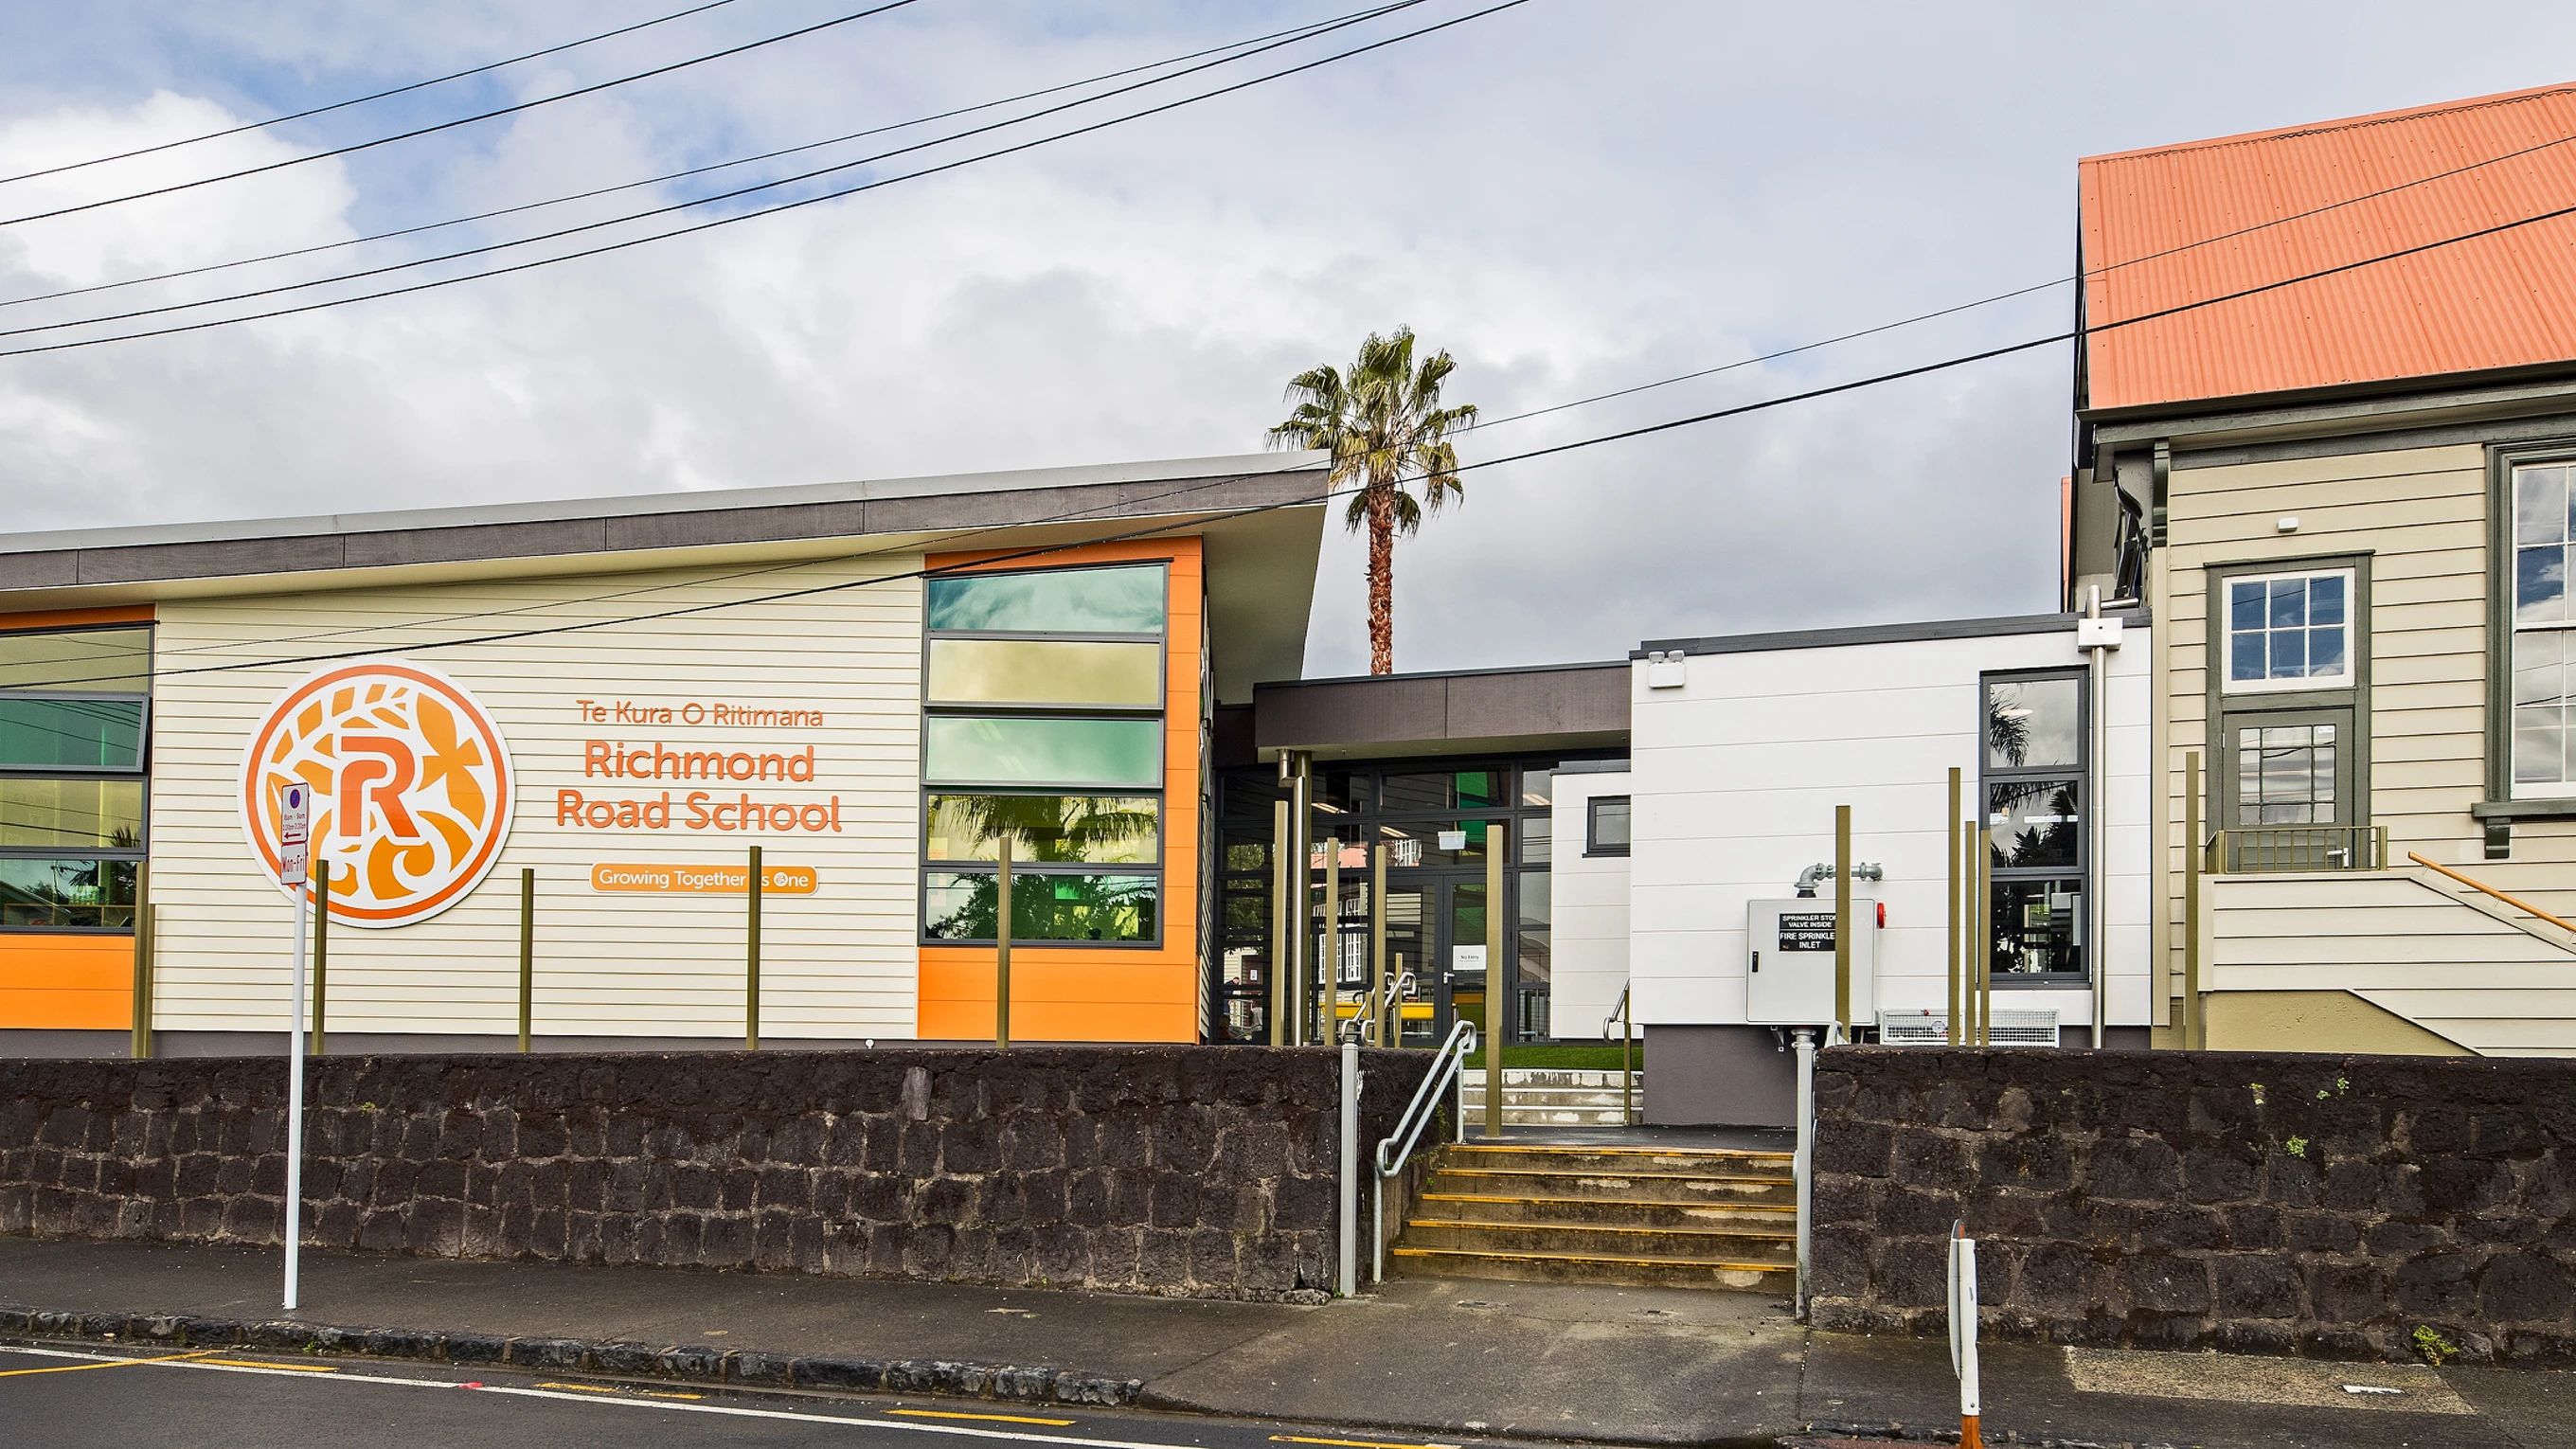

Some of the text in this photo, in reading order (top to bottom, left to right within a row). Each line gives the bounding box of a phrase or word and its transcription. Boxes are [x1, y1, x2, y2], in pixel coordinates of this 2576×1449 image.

[576, 699, 823, 726] Te Kura O Ritimana
[584, 739, 814, 782] Richmond
[557, 789, 842, 833] Road School
[599, 868, 809, 889] Growing Together s One
[1799, 940, 1821, 949] INLET
